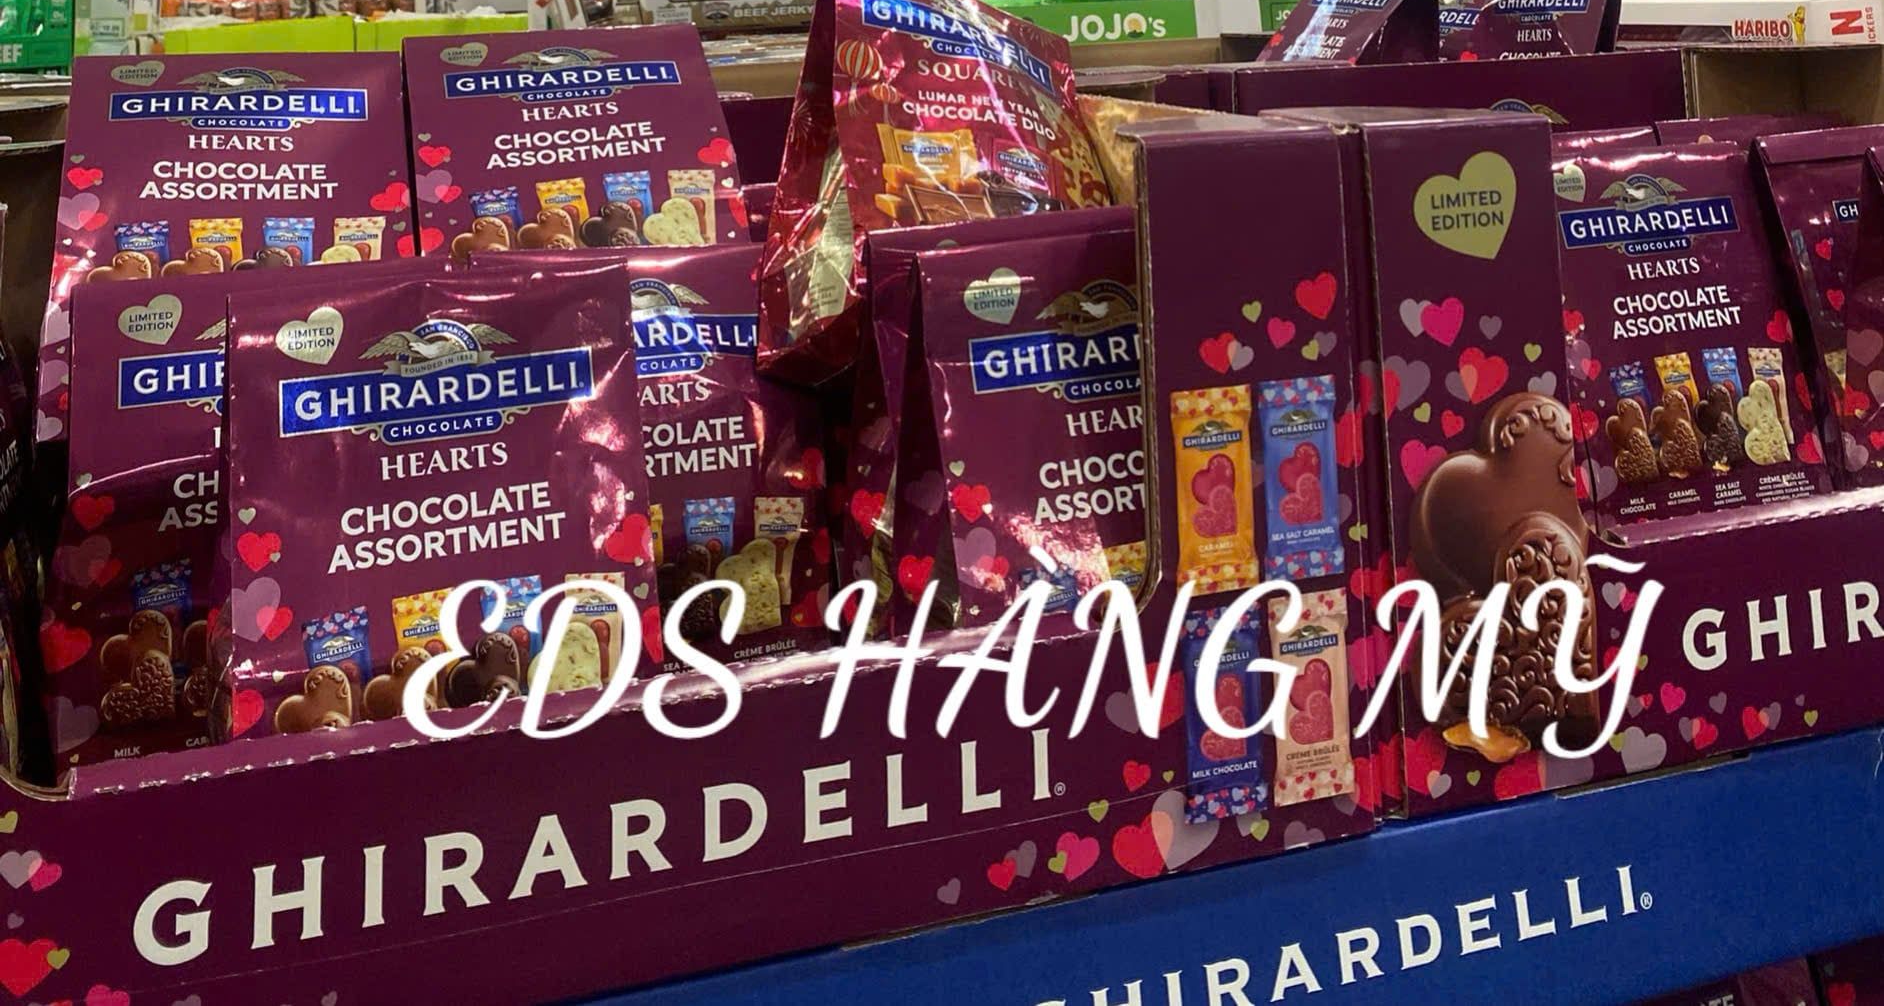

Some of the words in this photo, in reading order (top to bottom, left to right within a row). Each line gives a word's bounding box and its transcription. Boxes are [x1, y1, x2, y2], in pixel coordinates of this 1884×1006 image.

[734, 7, 768, 18] BEEF
[770, 4, 814, 16] JERKY
[1275, 9, 1291, 22] JO
[1439, 10, 1479, 25] RDELL
[1517, 28, 1552, 42] HEARTS
[1734, 19, 1790, 38] HARIBO
[0, 43, 23, 65] EF
[936, 41, 1008, 66] CHOCOLAT
[456, 66, 669, 92] GHIRARDELLI
[527, 89, 606, 100] CHOCOLATE
[122, 95, 355, 114] GHIRARDELLI
[521, 101, 619, 123] HEARTS
[918, 90, 966, 104] LUNAR
[971, 95, 1003, 110] NEW
[1008, 100, 1040, 119] YEAR
[197, 118, 285, 128] CHOCOLATE
[902, 101, 1017, 127] CHOCOLATE
[1021, 117, 1056, 141] DUO
[188, 134, 294, 152] HEARTS
[494, 122, 654, 151] CHOCOLATE
[486, 137, 666, 170] ASSORTMENT
[153, 161, 327, 181] CHOCOLATE
[139, 181, 338, 200] ASSORTMENT
[1555, 176, 1581, 186] LIMITED
[1556, 183, 1583, 193] EDITION
[1430, 190, 1503, 211] LIMITED
[1839, 203, 1859, 218] GH
[1431, 210, 1505, 232] EDITION
[1570, 204, 1730, 240] GHIRARDELLI
[1627, 239, 1688, 253] CHOCOLATE
[1627, 256, 1701, 282] HEARTS
[973, 288, 1014, 300] LIMITED
[1613, 284, 1731, 315] CHOCOLATE
[973, 298, 1015, 311] EDITION
[128, 320, 174, 333] EDITION
[129, 311, 173, 324] LIMITED
[1612, 305, 1742, 341] ASSORTMENT
[288, 326, 334, 340] LIMITED
[438, 323, 475, 349] FRANCISCO
[633, 323, 758, 348] ARDELLI
[287, 337, 336, 351] EDITION
[639, 357, 698, 372] COLATE
[983, 334, 1141, 379] GHIRAR
[404, 360, 443, 374] FOUNDED
[295, 360, 579, 421] GHIRARDELLI
[640, 380, 712, 407] ARTS
[1071, 380, 1142, 396] CHOCOLA
[390, 416, 495, 439] CHOCOLATE
[1066, 405, 1144, 437] HEAR
[1272, 421, 1327, 436] GHIRARDELLI
[642, 415, 745, 448] COLATE
[1185, 432, 1240, 447] GHIRARDELLI
[380, 442, 508, 481] HEARTS
[645, 443, 758, 478] RTMENT
[1039, 450, 1145, 490] CHOCO
[173, 469, 220, 498] CH
[1715, 483, 1727, 491] SEA
[1727, 480, 1740, 489] SALT
[1630, 497, 1645, 505] MILK
[1669, 488, 1698, 499] CARAMEL
[1716, 489, 1743, 499] CARAMEL
[340, 481, 552, 536] CHOCOLATE
[1034, 483, 1147, 526] ASSORT
[1620, 503, 1656, 515] CHOCOLATE
[158, 500, 218, 532] ASS
[327, 512, 566, 574] ASSORTMENT
[1271, 532, 1284, 541] SEA
[1286, 530, 1301, 540] SALT
[1303, 526, 1335, 538] CARAMEL
[404, 623, 440, 637] GHIRARDE
[1683, 580, 1884, 671] GHIR
[315, 640, 363, 661] GHIRARDELLI
[766, 638, 798, 653] BRÛLÉE
[1282, 636, 1337, 652] GHIRARDELLI
[186, 735, 208, 746] CAR
[114, 745, 141, 758] MILK
[1192, 768, 1211, 779] MILK
[1213, 760, 1257, 776] CHOCOLATE
[133, 728, 1051, 966] GHIRARDELLI
